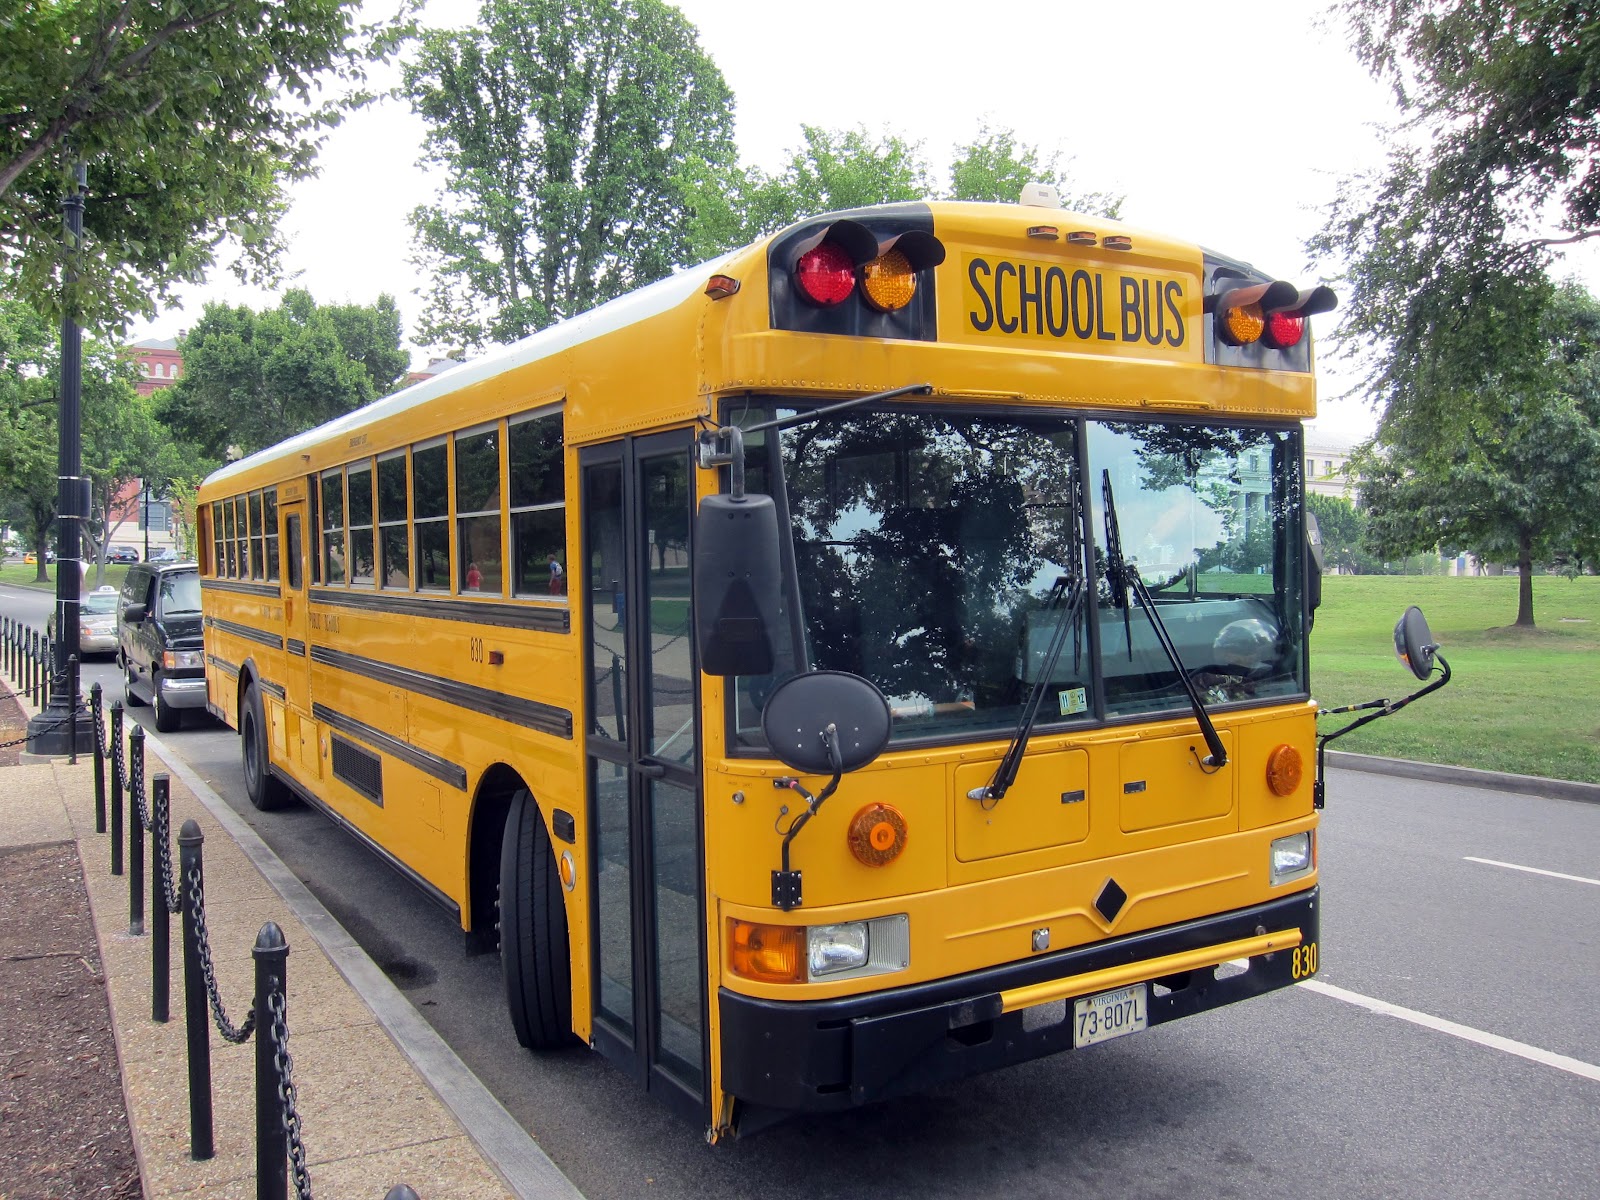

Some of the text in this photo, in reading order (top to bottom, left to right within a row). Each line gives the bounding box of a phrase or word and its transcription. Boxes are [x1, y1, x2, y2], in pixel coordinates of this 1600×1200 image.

[968, 258, 1185, 347] SCHOOL BUS
[471, 637, 483, 663] 830
[1061, 694, 1069, 708] 11
[1292, 942, 1317, 979] 830
[1093, 991, 1129, 1007] VIRGINIA
[1078, 999, 1143, 1038] 73-807L
